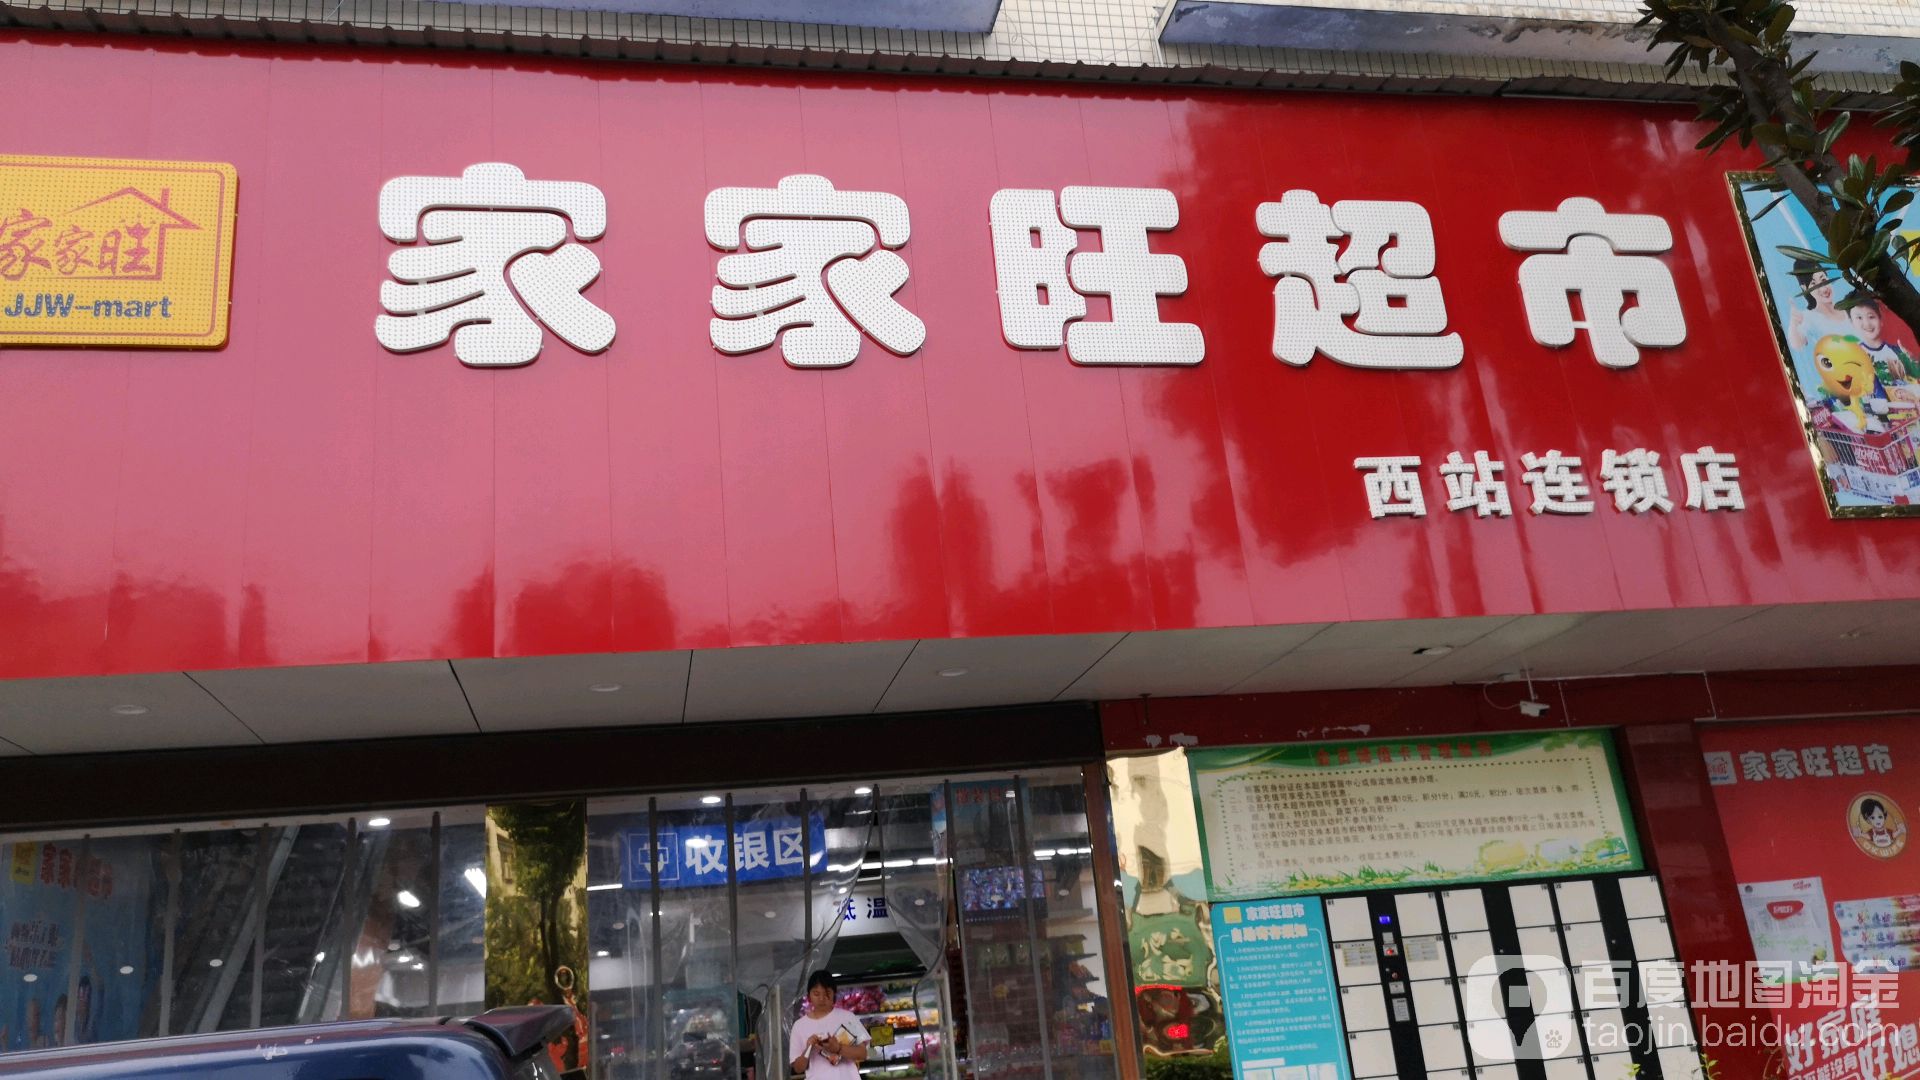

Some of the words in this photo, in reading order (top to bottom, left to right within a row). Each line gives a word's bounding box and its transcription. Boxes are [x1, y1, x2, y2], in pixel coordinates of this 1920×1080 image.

[374, 162, 1687, 369] 家家旺超市
[4, 293, 173, 318] JJW-mart
[1352, 446, 1745, 519] 西站连锁店
[1738, 743, 1893, 781] 家家旺超市
[685, 827, 806, 876] 收银区
